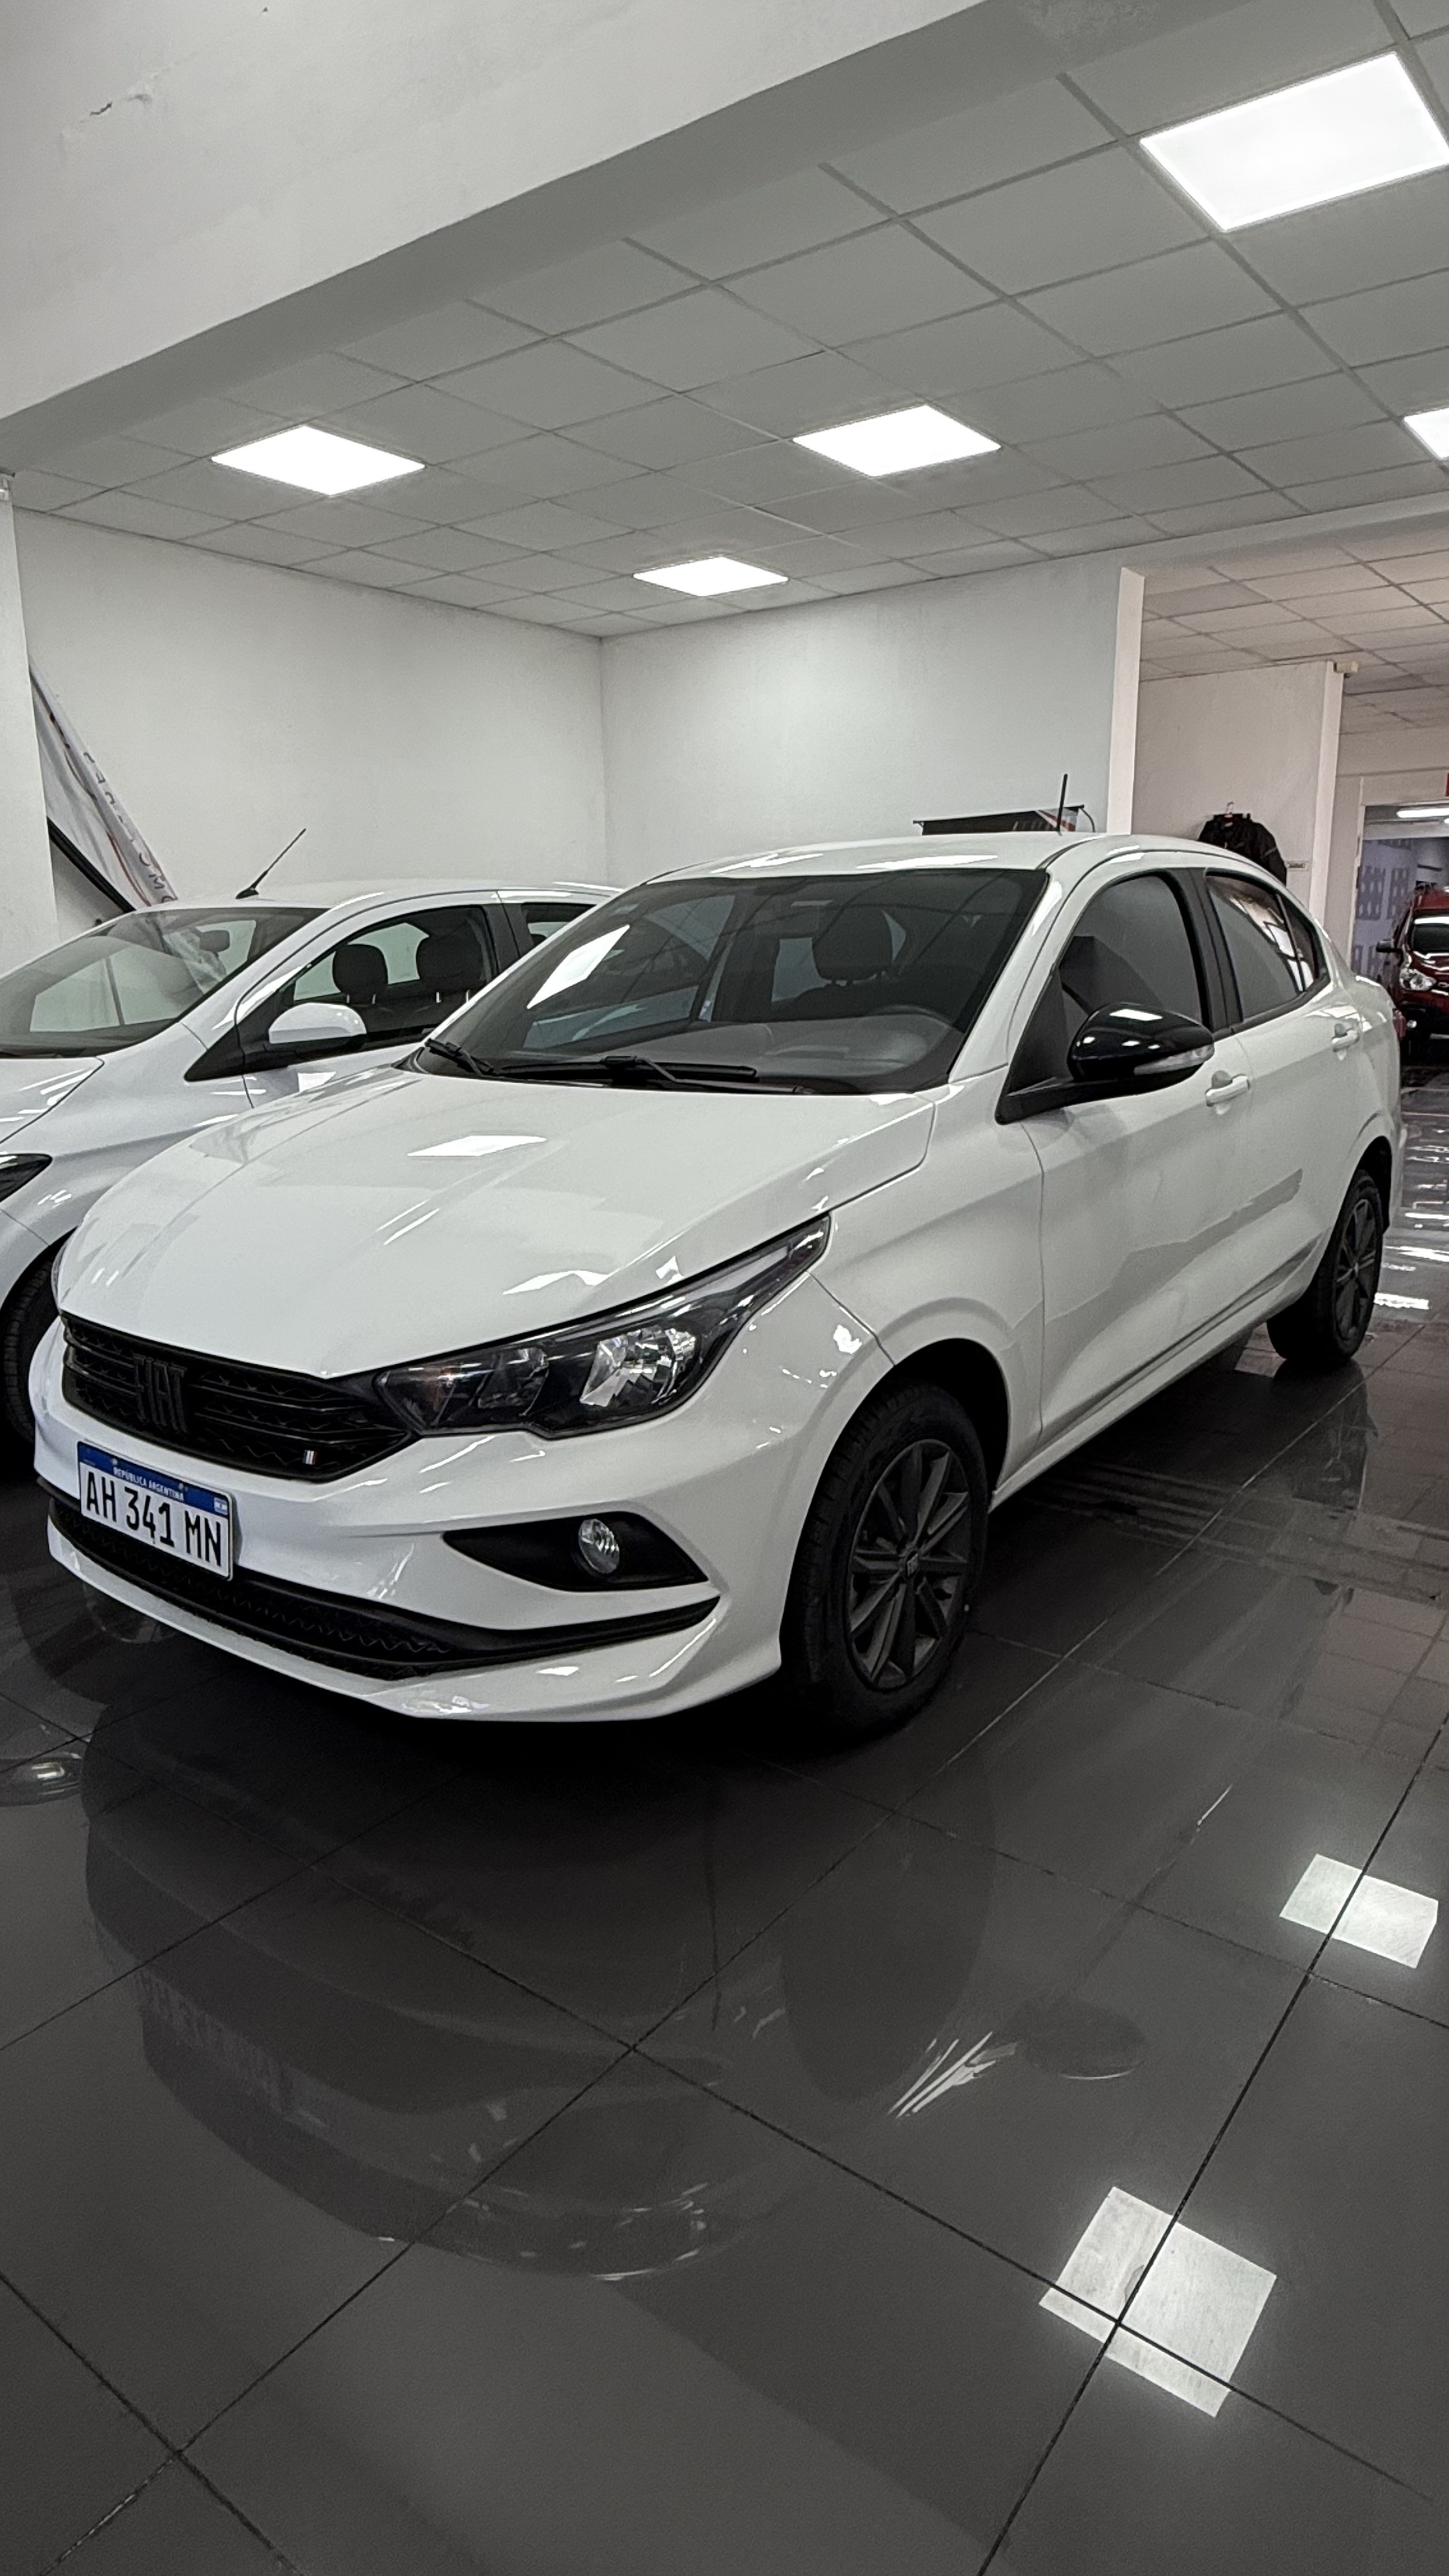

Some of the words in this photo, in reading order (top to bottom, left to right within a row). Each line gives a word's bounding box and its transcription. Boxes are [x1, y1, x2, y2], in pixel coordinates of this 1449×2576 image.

[132, 1354, 188, 1433] FIAT
[86, 1471, 118, 1522] AH
[124, 1486, 175, 1548] 341
[184, 1510, 222, 1567] MN
[148, 1480, 184, 1502] ARGENTINA
